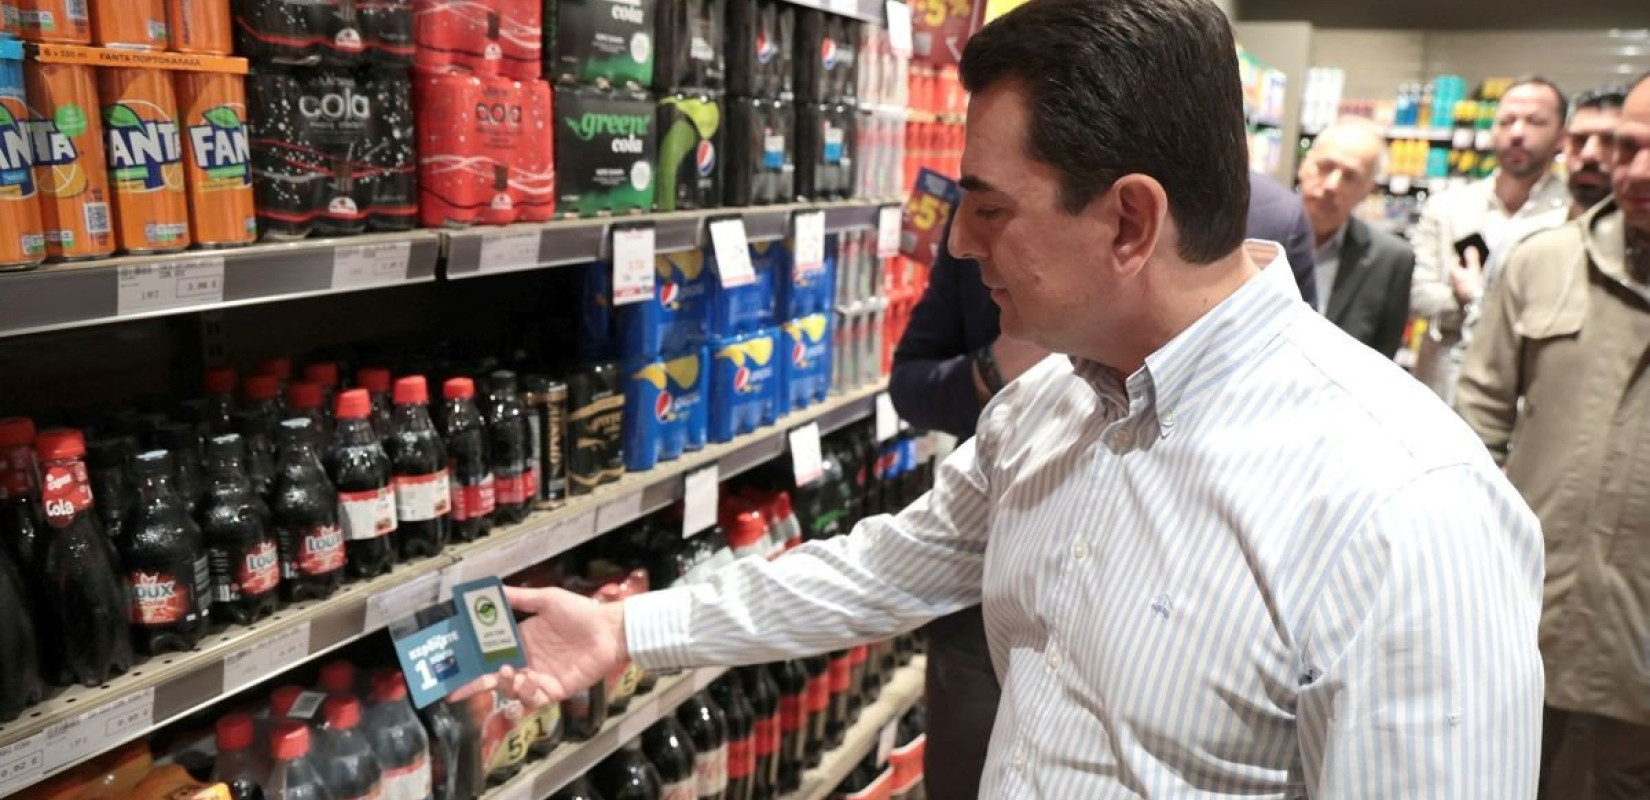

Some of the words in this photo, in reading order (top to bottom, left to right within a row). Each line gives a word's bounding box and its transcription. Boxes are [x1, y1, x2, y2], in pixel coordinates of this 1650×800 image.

[100, 52, 130, 62] FANTA
[299, 88, 370, 120] cola
[582, 113, 646, 140] green
[612, 133, 643, 152] cola
[46, 499, 74, 517] Cola
[415, 659, 438, 690] 1
